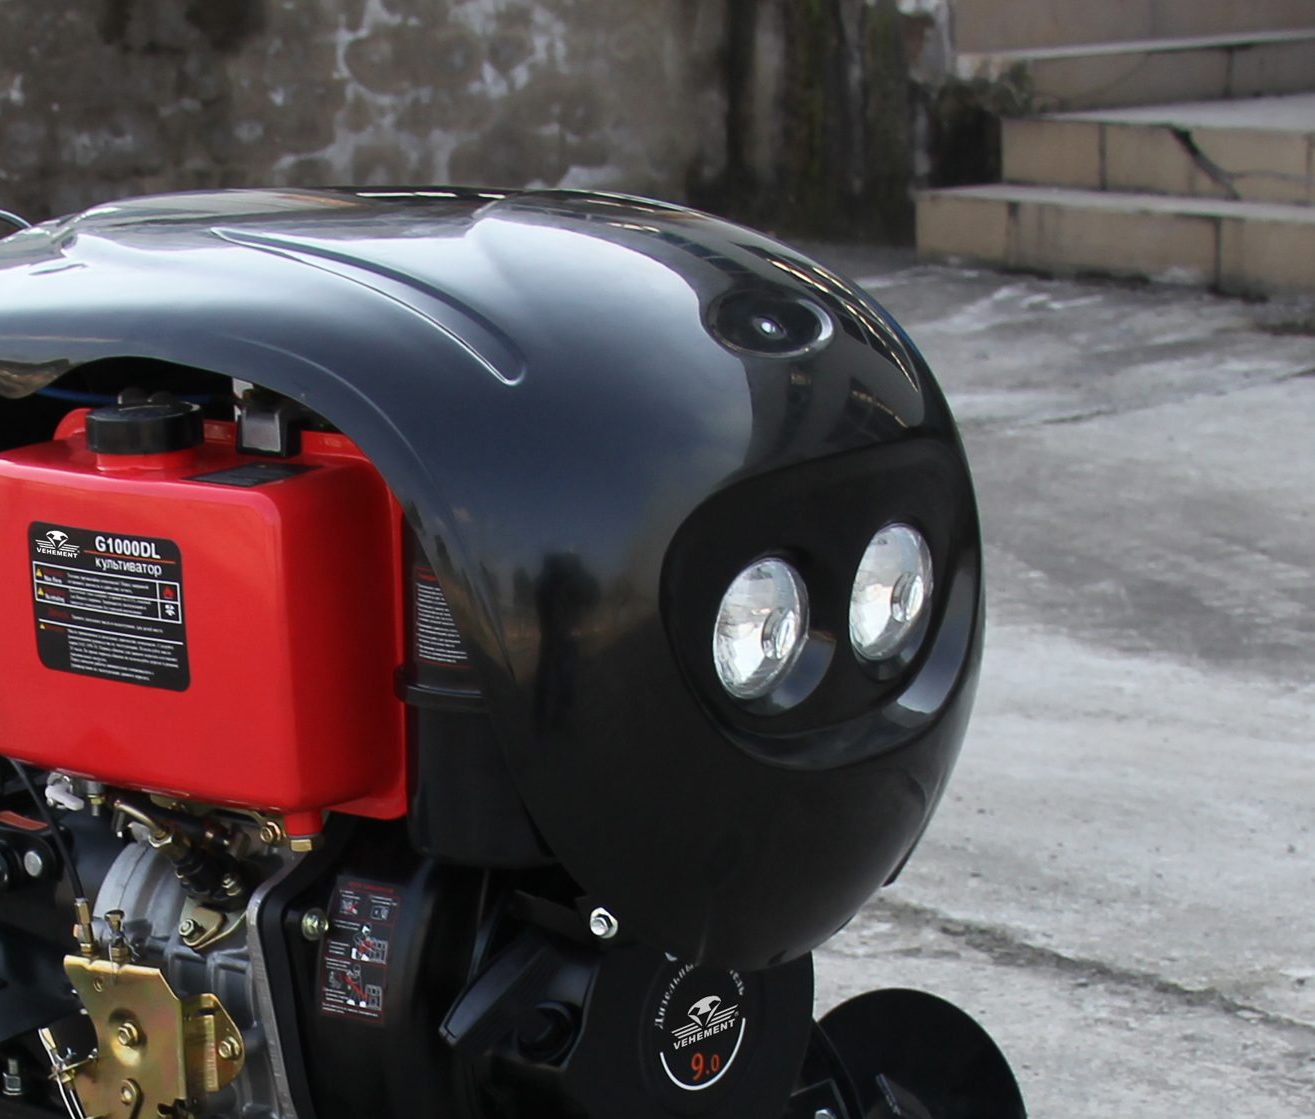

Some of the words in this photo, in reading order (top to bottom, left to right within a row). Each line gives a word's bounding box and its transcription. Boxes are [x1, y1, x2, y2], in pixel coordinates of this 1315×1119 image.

[36, 547, 78, 559] VEHEMENT
[95, 535, 161, 559] G1000DL
[95, 557, 162, 577] культиватор
[654, 963, 698, 1029] Дизельны
[673, 1018, 736, 1050] VEHEMENT
[691, 1052, 721, 1081] 9.0
